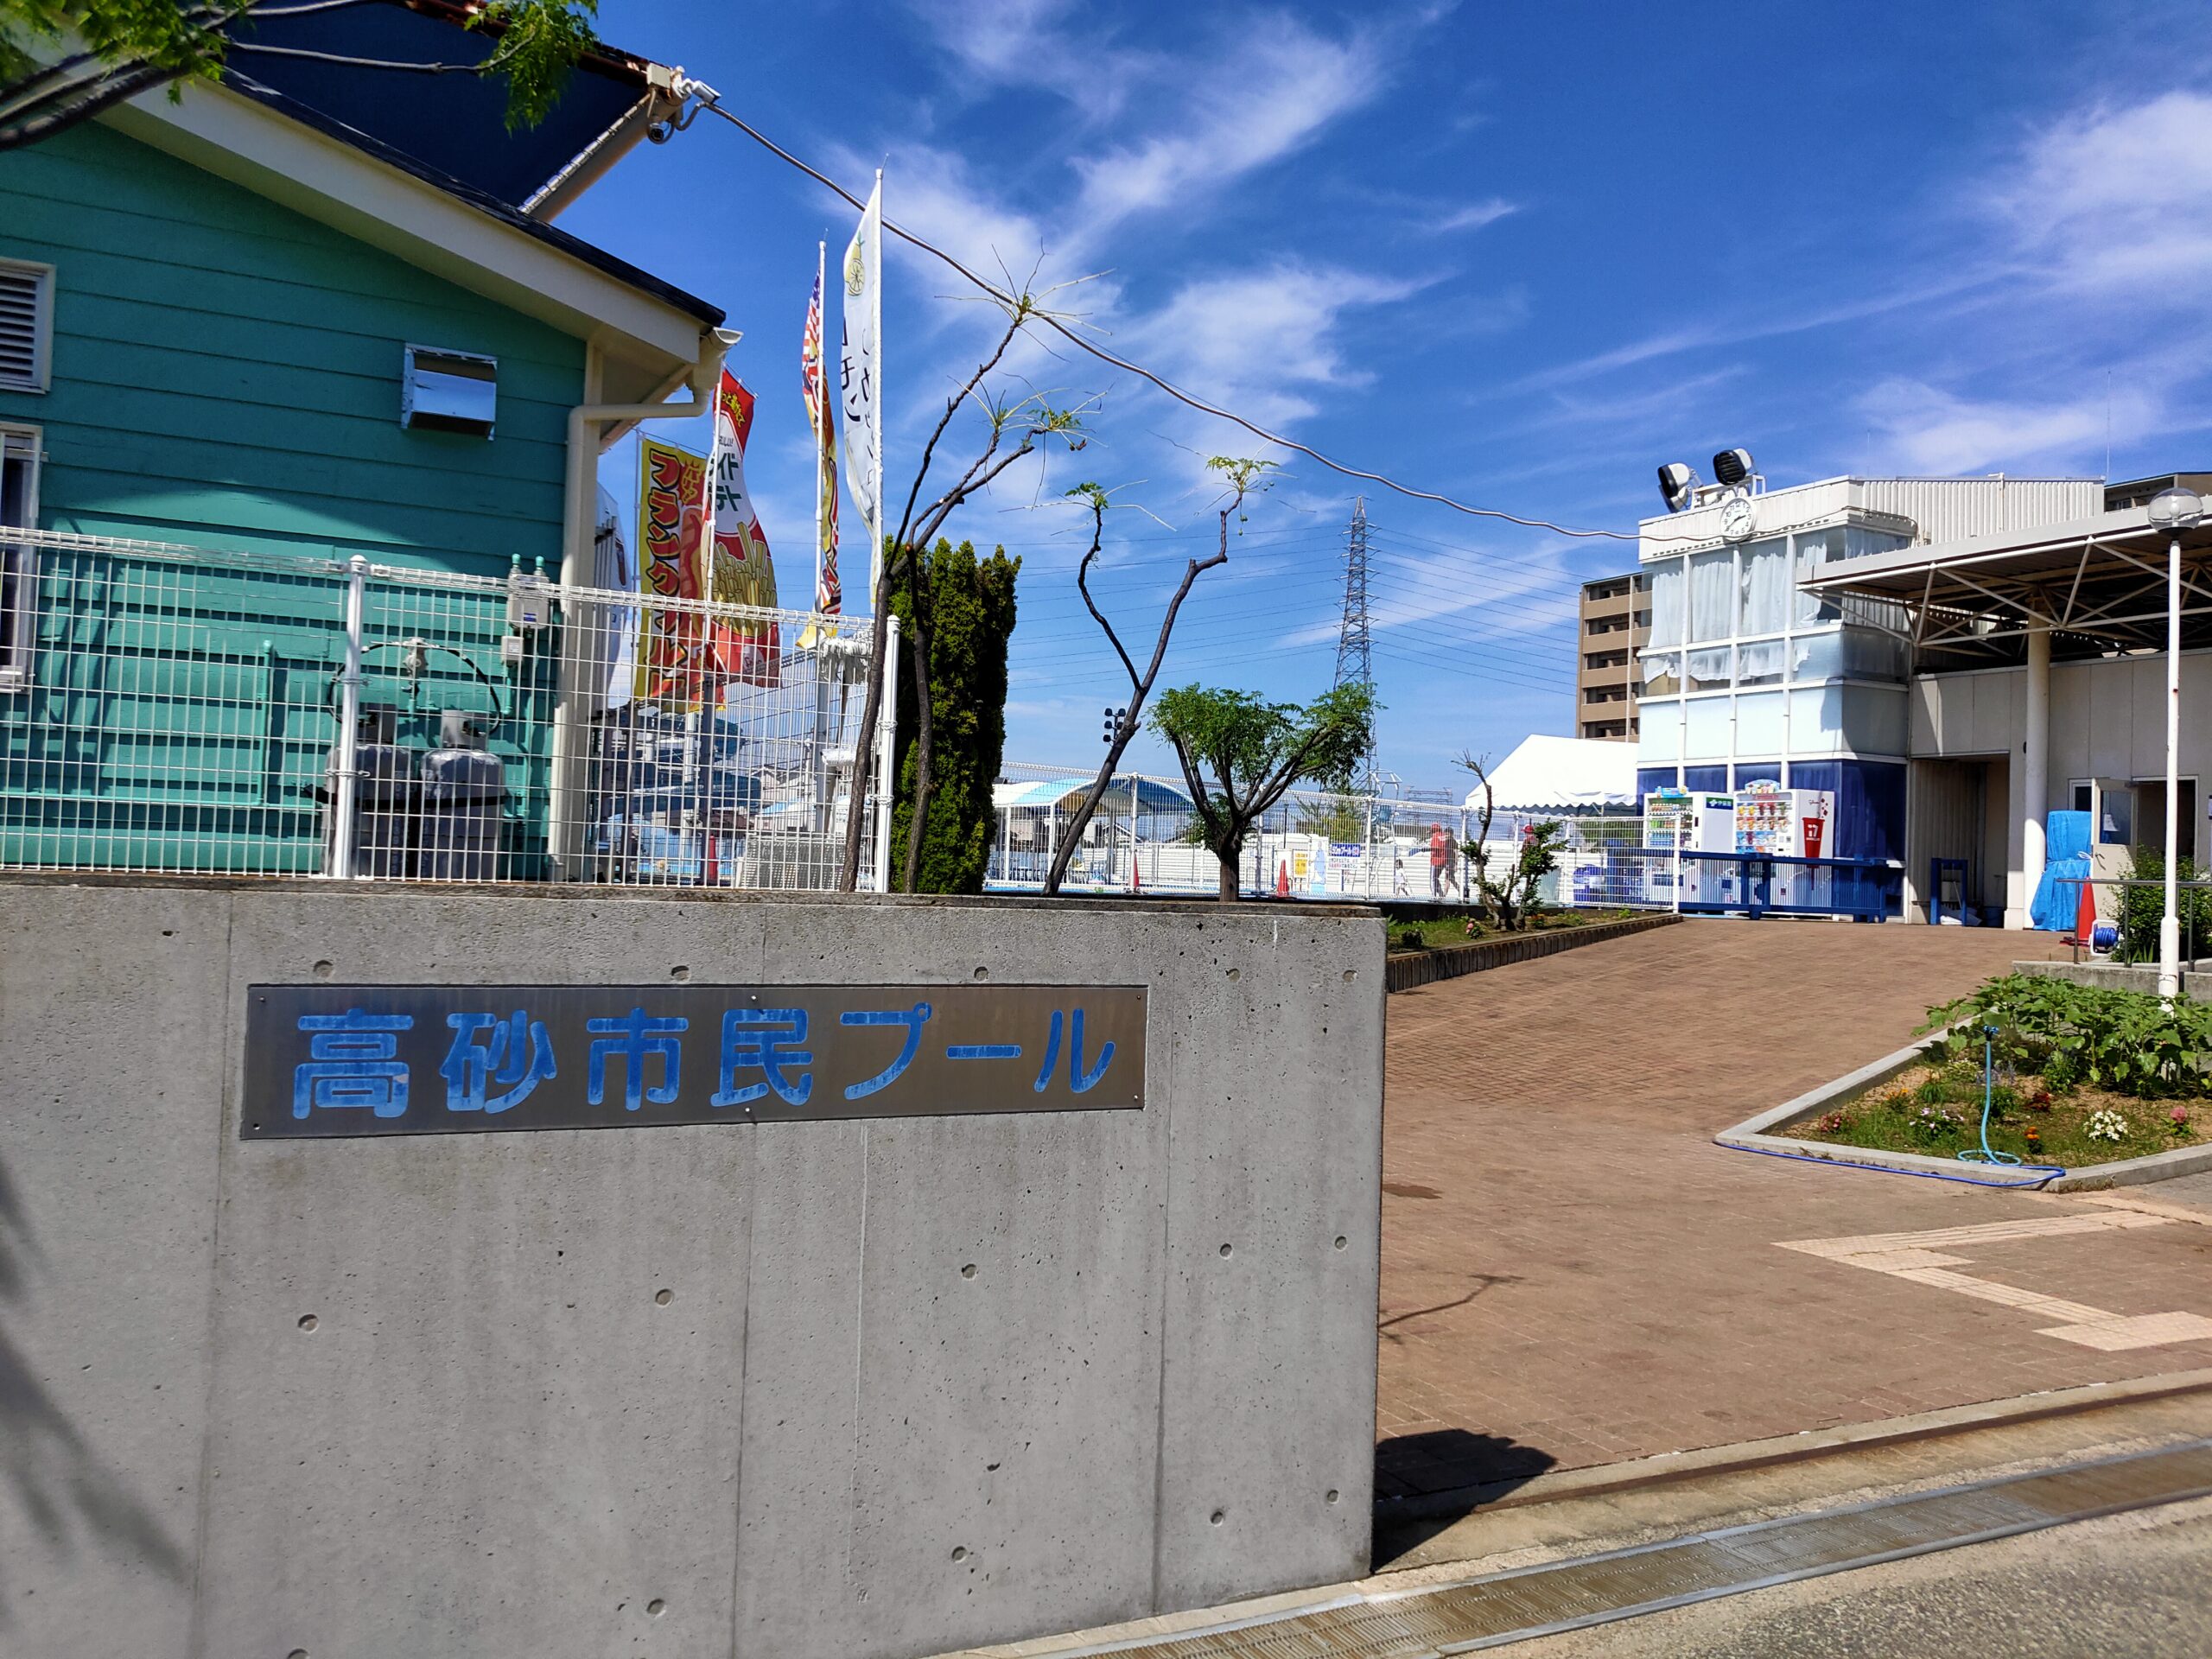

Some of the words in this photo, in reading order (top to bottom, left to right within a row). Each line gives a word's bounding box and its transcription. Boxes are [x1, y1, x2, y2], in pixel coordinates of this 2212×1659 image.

[293, 1002, 1116, 1120] 高砂市民プール
